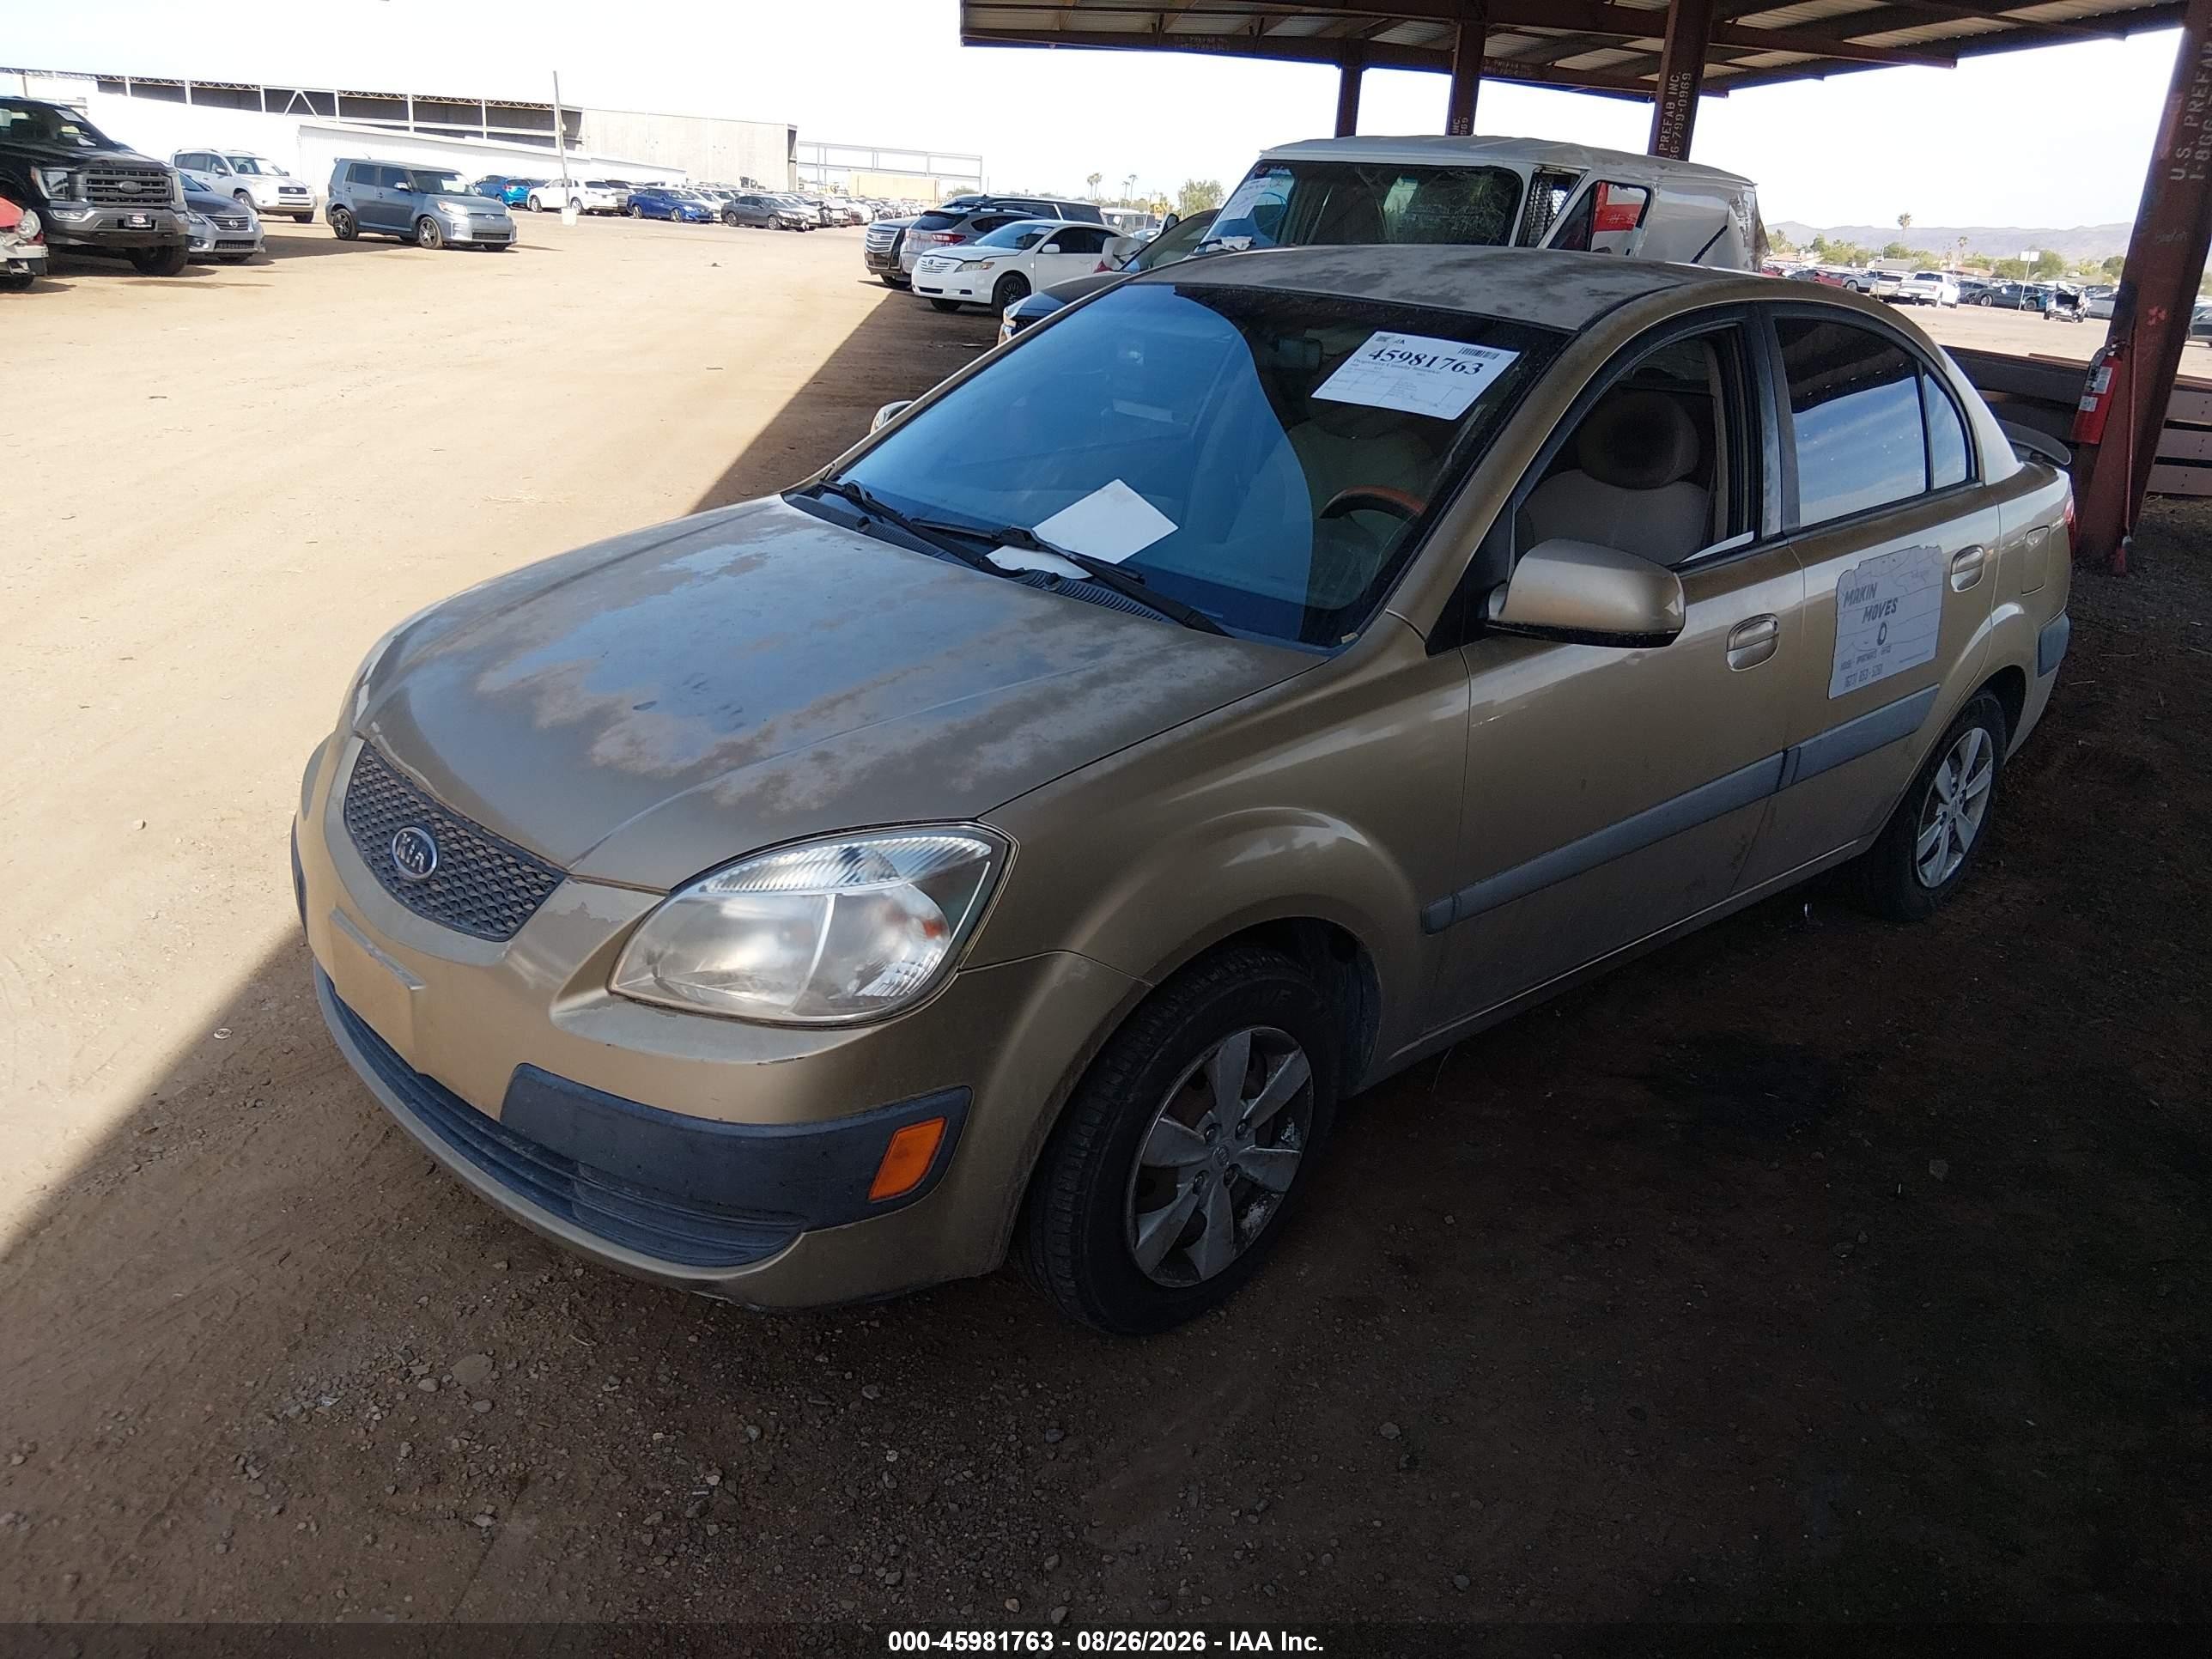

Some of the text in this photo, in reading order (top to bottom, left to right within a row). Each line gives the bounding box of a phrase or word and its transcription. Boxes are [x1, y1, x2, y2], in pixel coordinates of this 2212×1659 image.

[1658, 71, 1681, 151] PREFAB INC.
[1368, 347, 1484, 375] 45981763
[1862, 597, 1899, 624] MOVES
[397, 832, 425, 873] KIA
